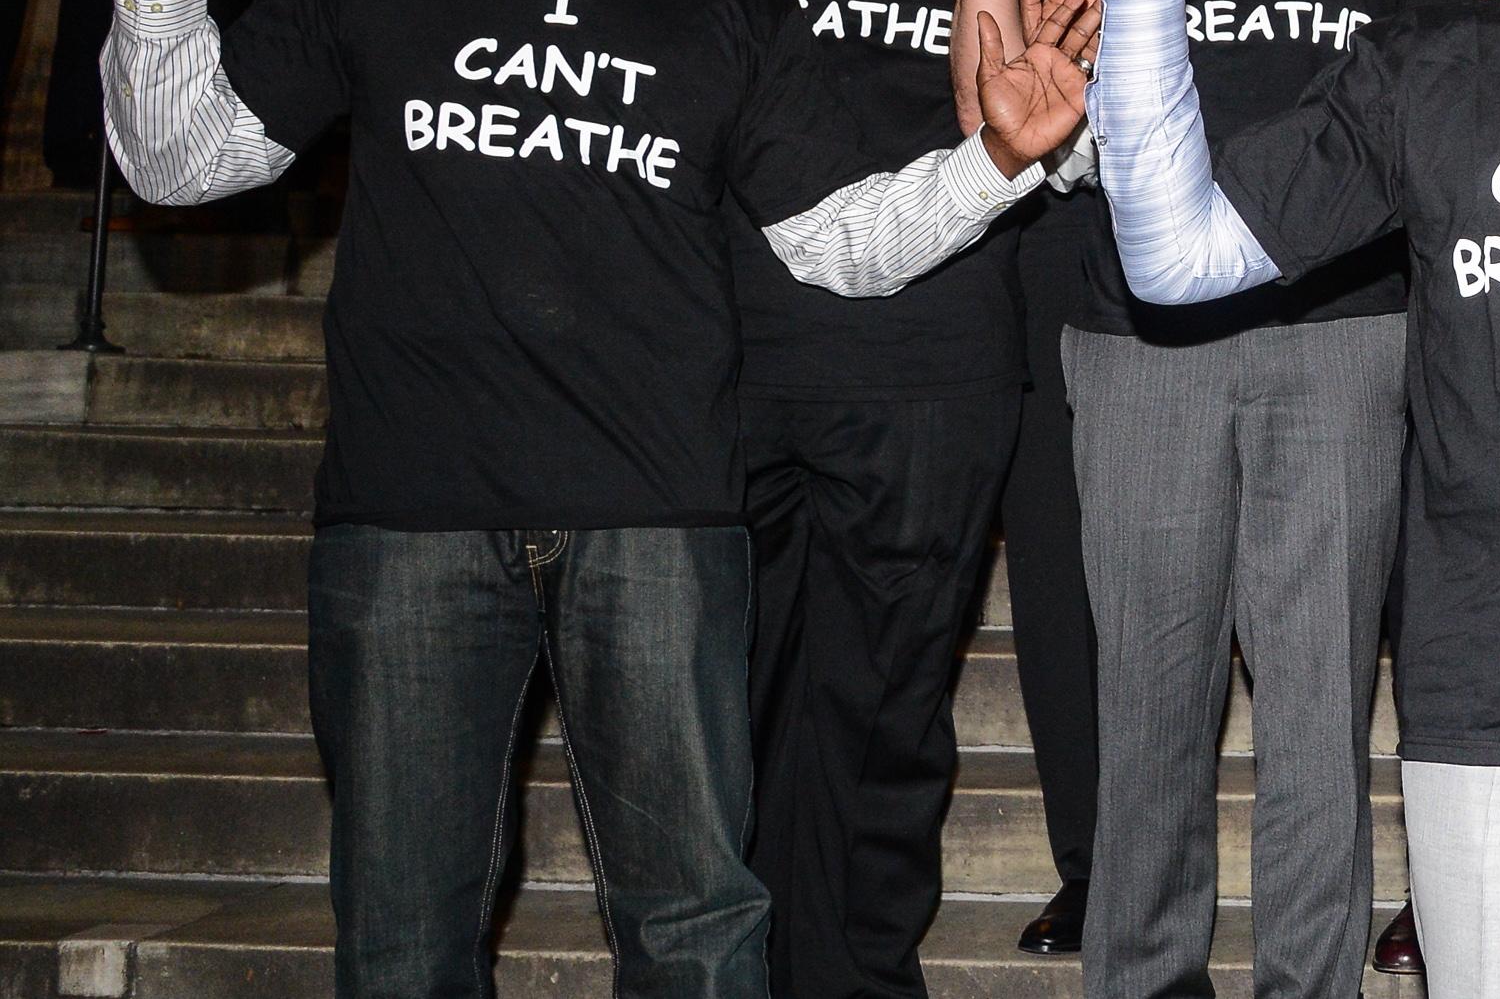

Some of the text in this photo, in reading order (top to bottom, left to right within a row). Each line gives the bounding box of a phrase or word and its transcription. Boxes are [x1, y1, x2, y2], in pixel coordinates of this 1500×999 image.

[1185, 0, 1372, 52] REATH
[454, 38, 656, 105] CAN'T
[404, 99, 680, 189] BREATHE
